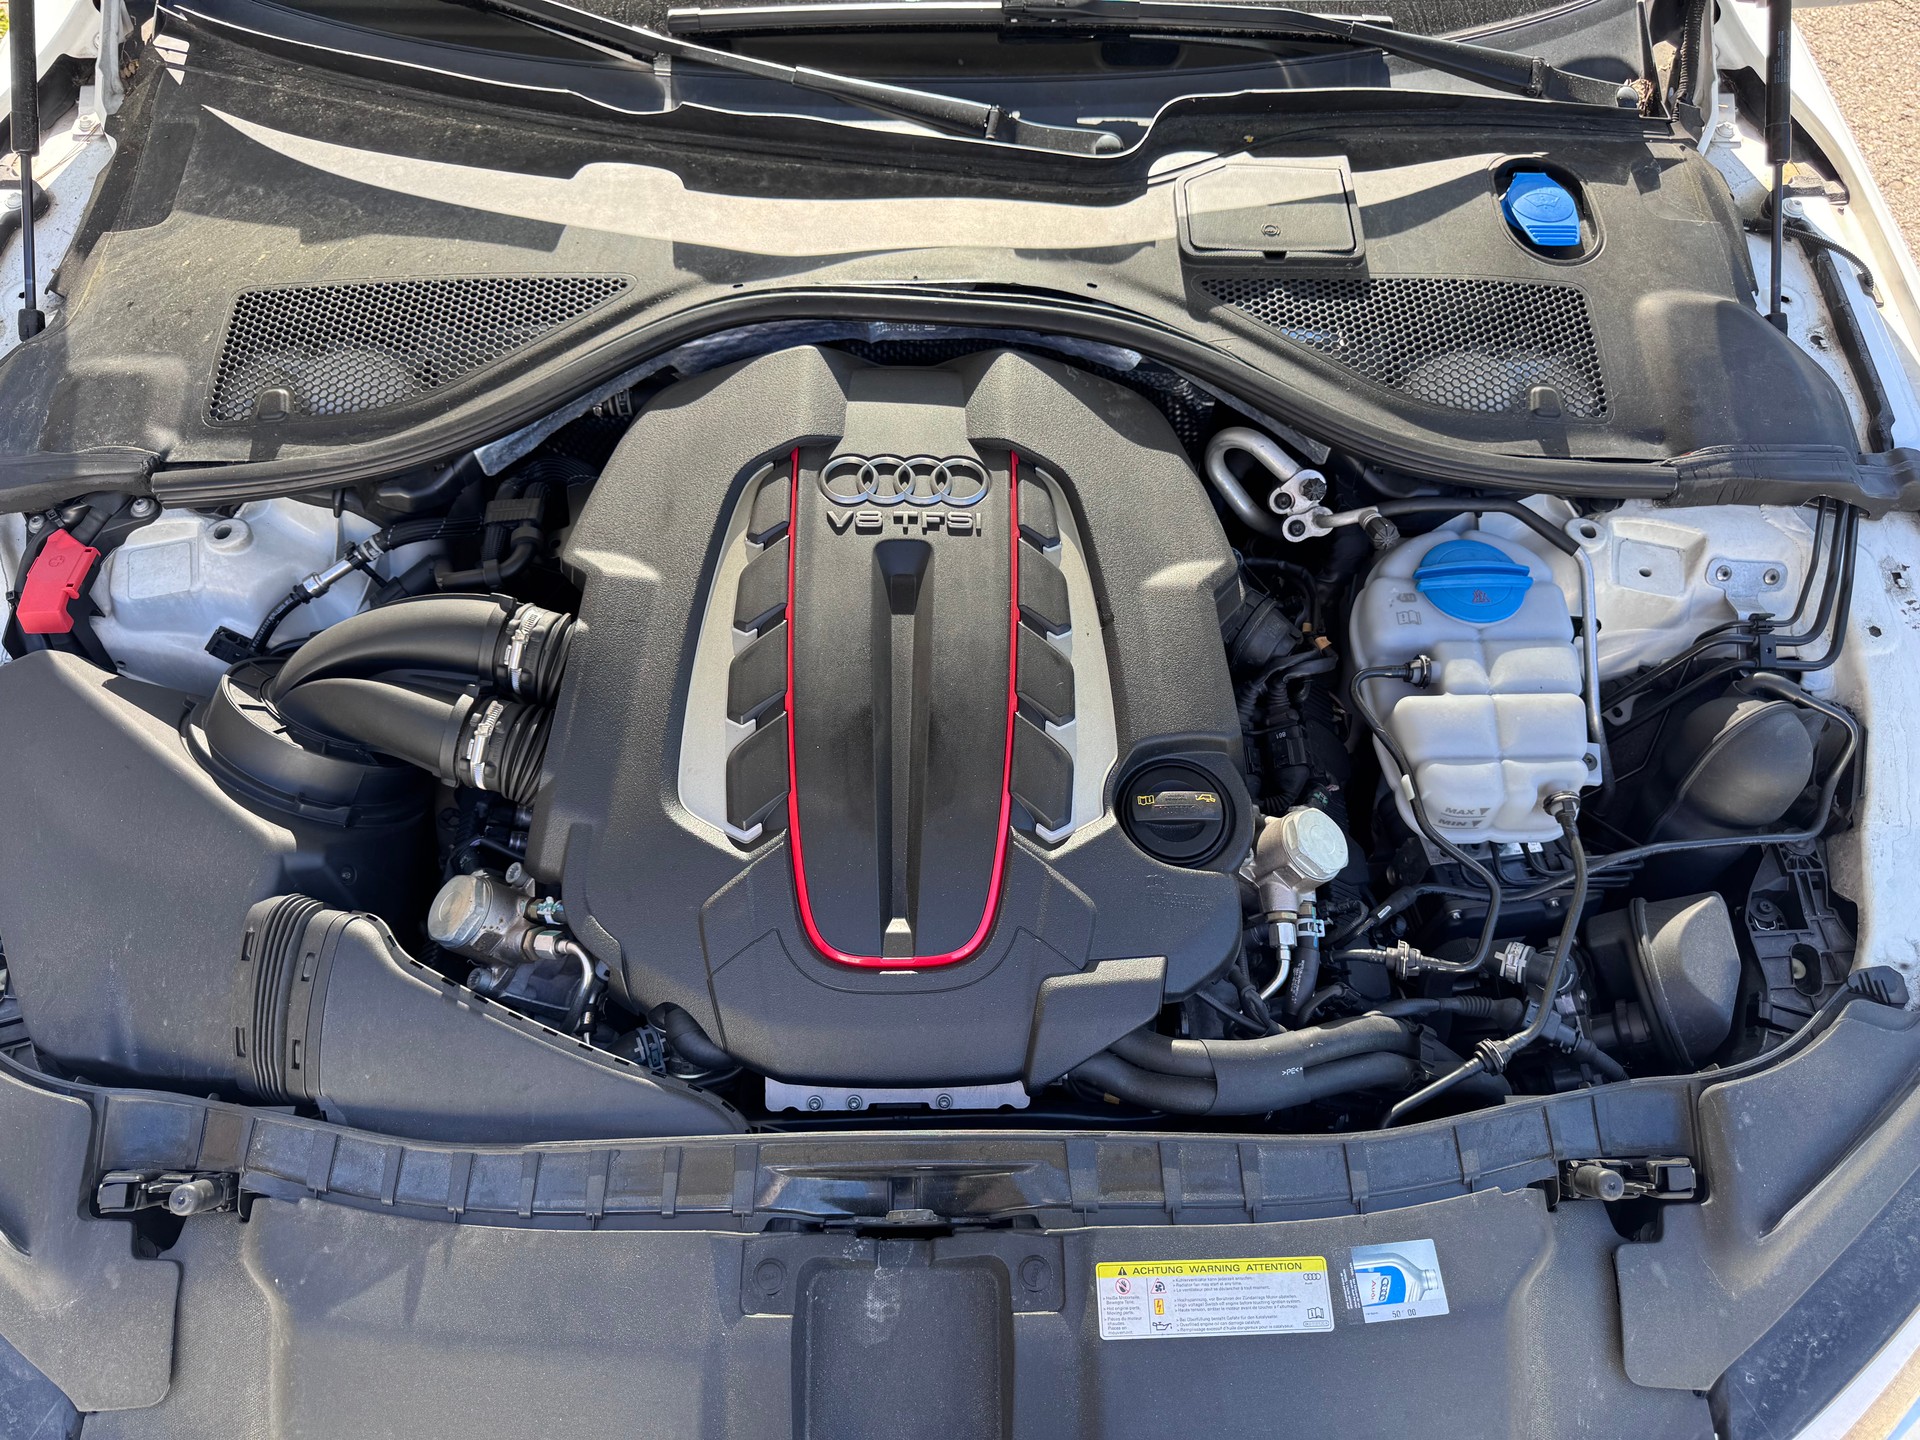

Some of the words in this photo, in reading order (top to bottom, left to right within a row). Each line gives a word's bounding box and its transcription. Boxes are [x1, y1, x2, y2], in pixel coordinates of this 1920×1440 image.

[827, 510, 883, 530] V8
[893, 511, 982, 531] TFSI
[1445, 807, 1474, 815] MAX
[1132, 1266, 1183, 1275] ACHTUNG
[1189, 1264, 1240, 1273] WARNING
[1246, 1262, 1302, 1272] ATTENTION
